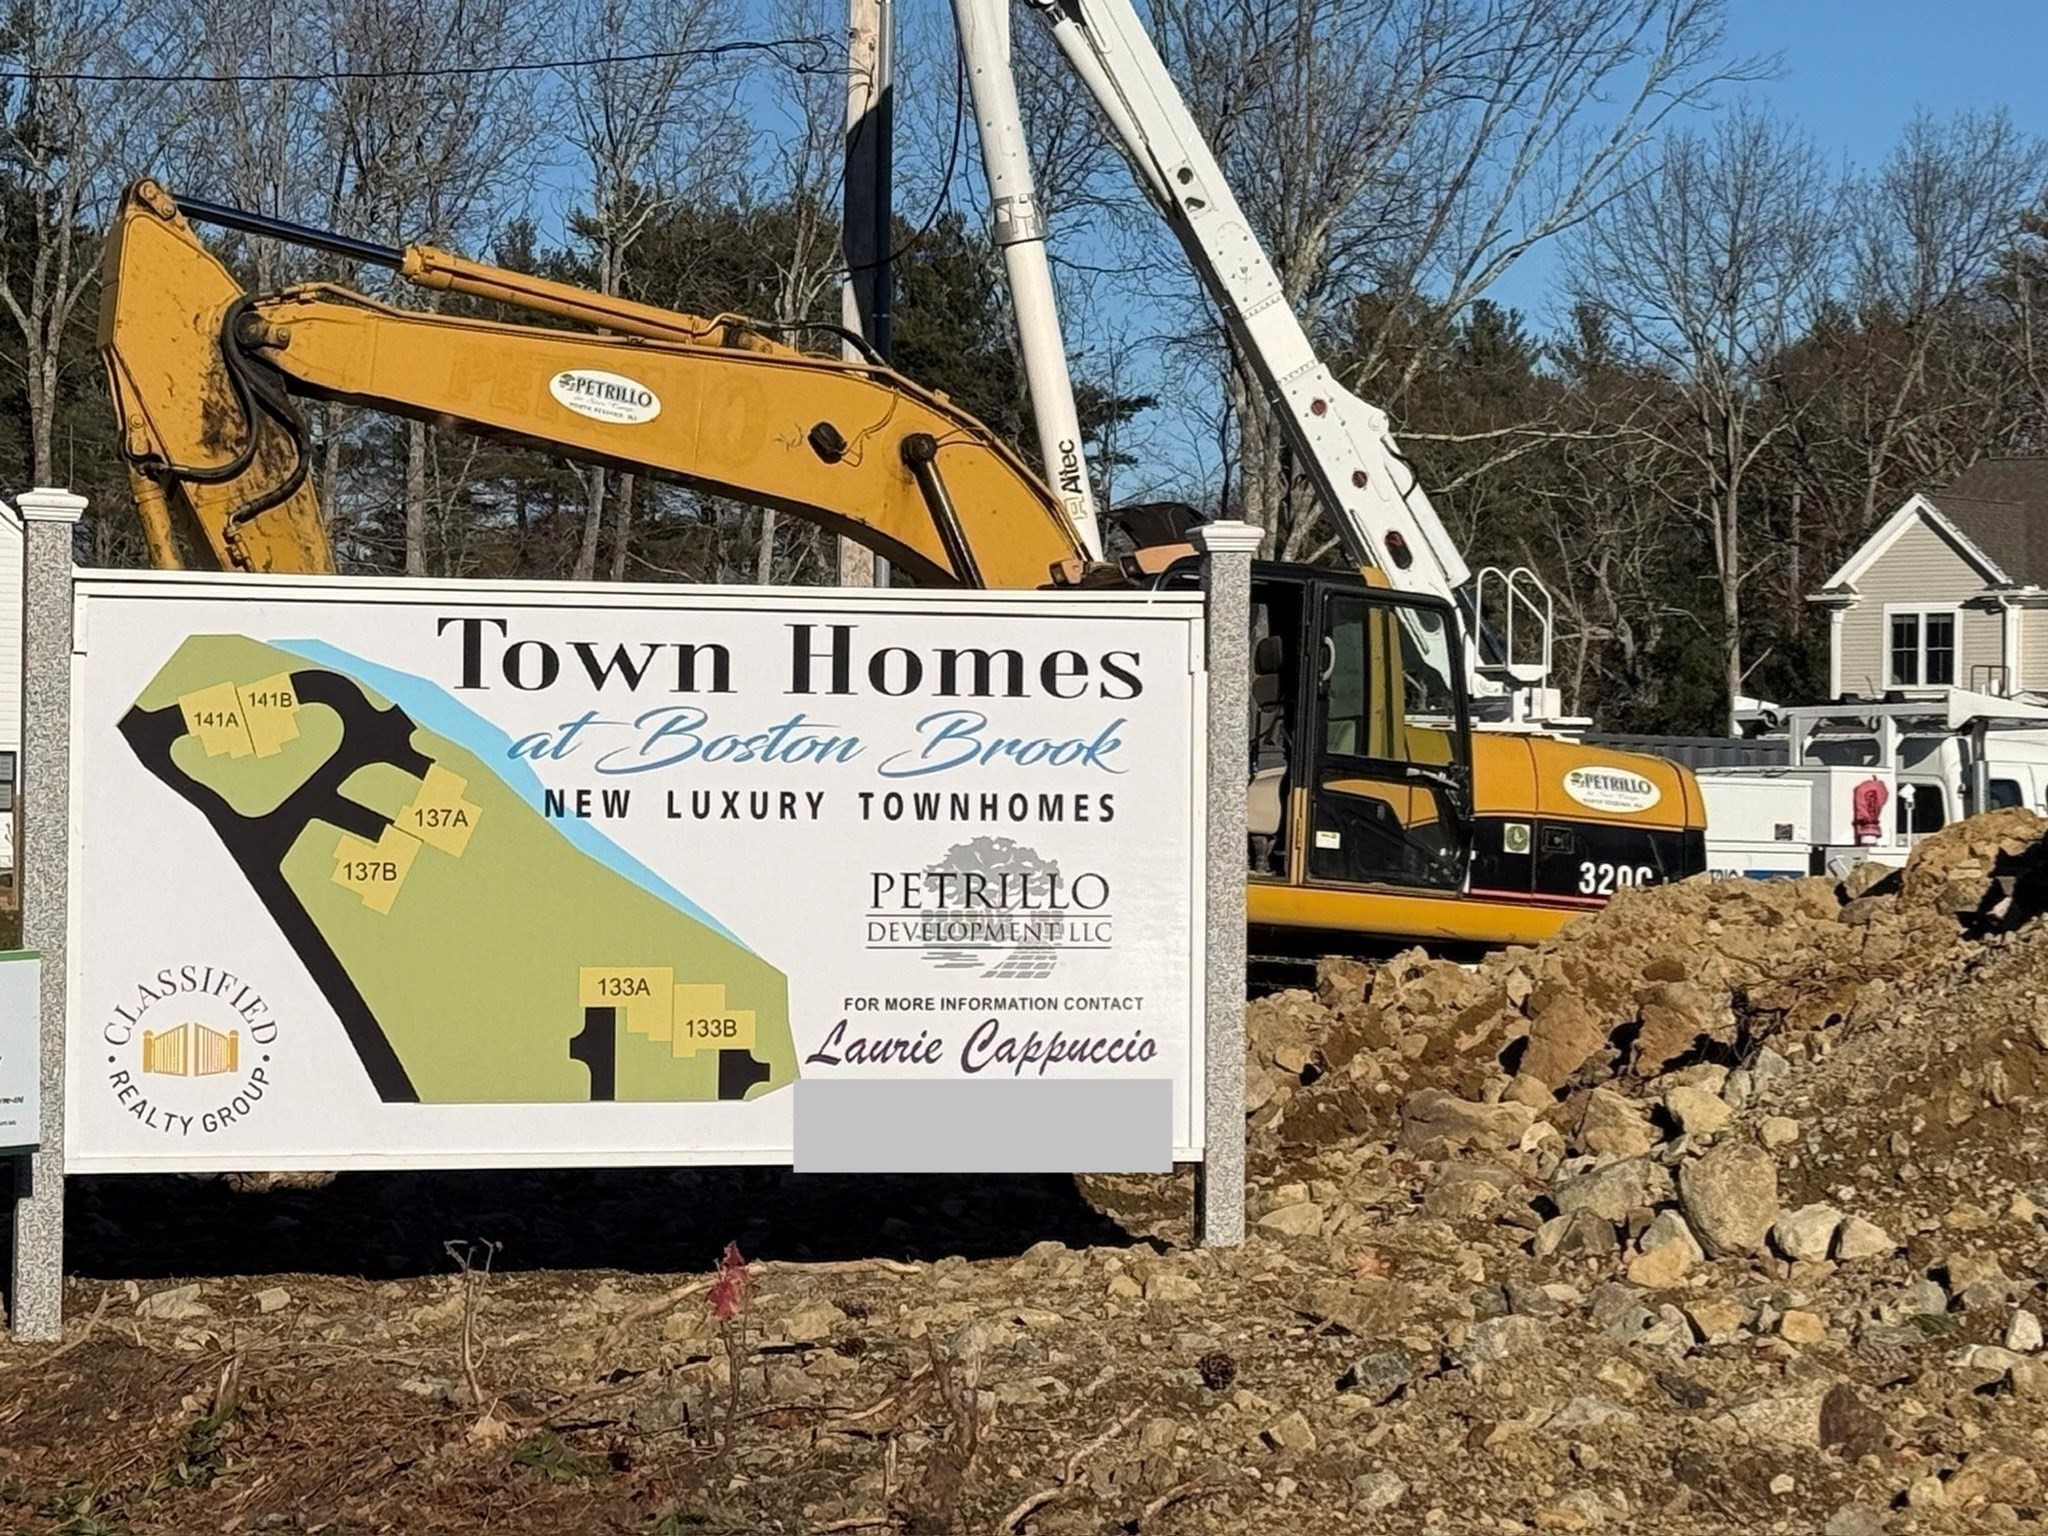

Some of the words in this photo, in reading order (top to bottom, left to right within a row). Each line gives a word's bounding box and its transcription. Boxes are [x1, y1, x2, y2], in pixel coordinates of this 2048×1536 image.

[576, 376, 652, 408] PETRILLO
[1058, 438, 1083, 494] Altec
[437, 617, 738, 693] Town
[783, 623, 1143, 700] Homes
[248, 692, 292, 708] 141B
[194, 712, 239, 728] 141A
[507, 710, 632, 760] at
[595, 705, 867, 775] Boston
[877, 709, 1131, 778] Brook
[1584, 773, 1651, 795] PETRILLO
[414, 808, 468, 828] 137A
[544, 788, 631, 818] NEW
[667, 790, 825, 820] LUXURY
[858, 792, 1115, 823] TOWNHOMES
[343, 862, 397, 882] 137B
[1578, 861, 1653, 895] 320C
[870, 872, 1110, 910] PETRILLO
[867, 921, 1061, 943] DEVELOPMENT
[1069, 922, 1113, 943] LLC
[597, 978, 651, 996] 133A
[103, 965, 278, 1046] CLASSIFIED
[844, 998, 880, 1011] FOR
[885, 998, 935, 1011] MORE
[941, 998, 1059, 1011] INFORMATION
[1064, 998, 1144, 1011] CONTACT
[685, 1019, 738, 1038] 133B
[805, 1018, 943, 1066] Laurie
[960, 1018, 1158, 1077] Cappuccio
[109, 1070, 194, 1136] REALTY
[202, 1067, 270, 1133] GROUP
